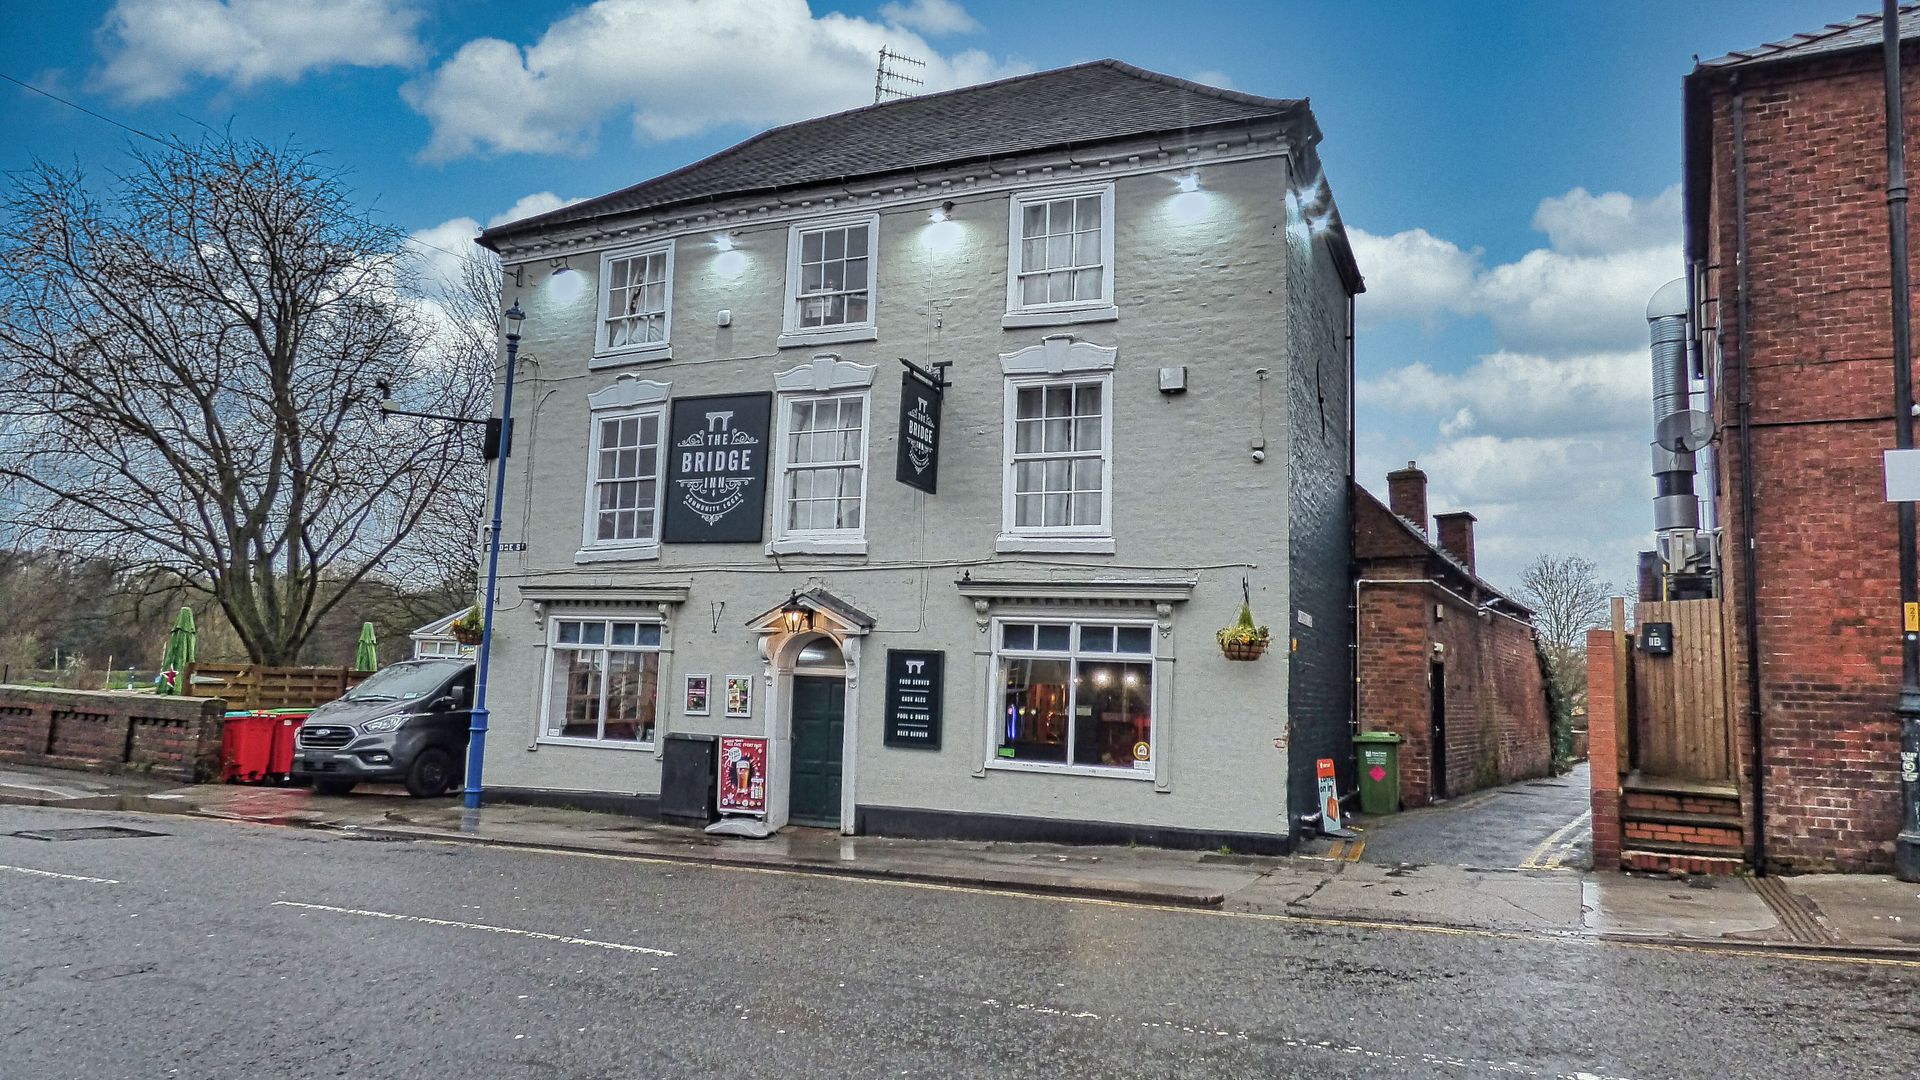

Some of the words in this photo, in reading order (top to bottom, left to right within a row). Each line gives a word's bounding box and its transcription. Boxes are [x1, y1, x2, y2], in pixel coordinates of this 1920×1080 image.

[908, 419, 933, 444] BRIDGE
[708, 433, 729, 446] THE
[681, 449, 752, 473] BRIDGE
[704, 476, 725, 489] INN
[684, 493, 720, 512] COMMUNITY
[723, 491, 743, 509] LOCAL
[486, 543, 514, 552] BDGE
[896, 712, 909, 720] POOL
